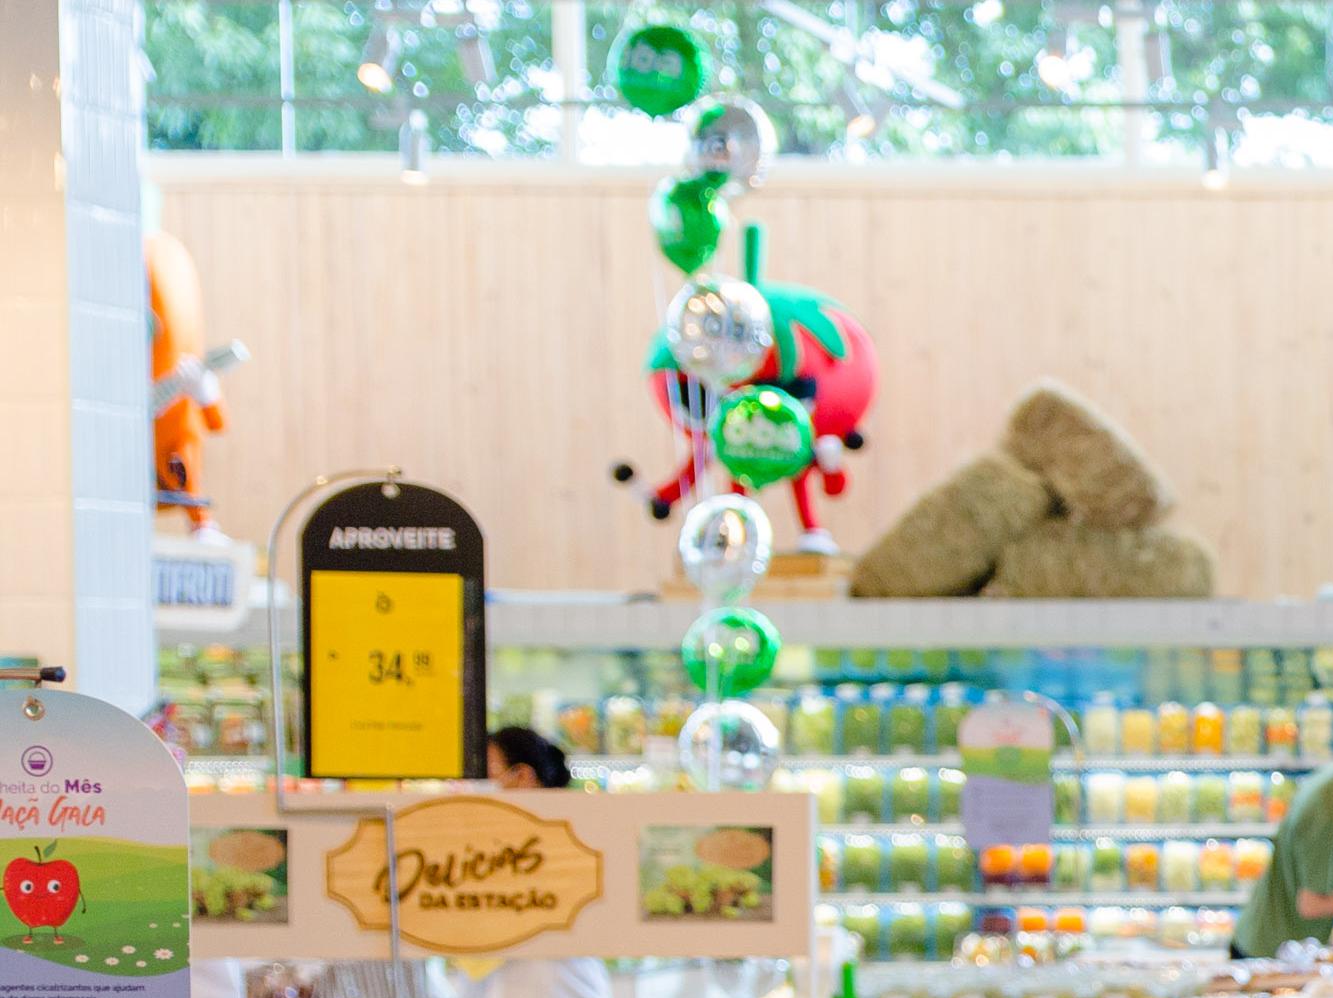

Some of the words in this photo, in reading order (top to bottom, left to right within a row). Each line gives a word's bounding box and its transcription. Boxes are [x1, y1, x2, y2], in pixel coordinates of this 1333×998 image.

[328, 526, 456, 550] APROVEITE
[40, 781, 60, 794] do
[65, 779, 102, 793] Mês
[420, 893, 448, 911] DA
[455, 889, 557, 914] ESTAÇÃO
[93, 985, 111, 993] que
